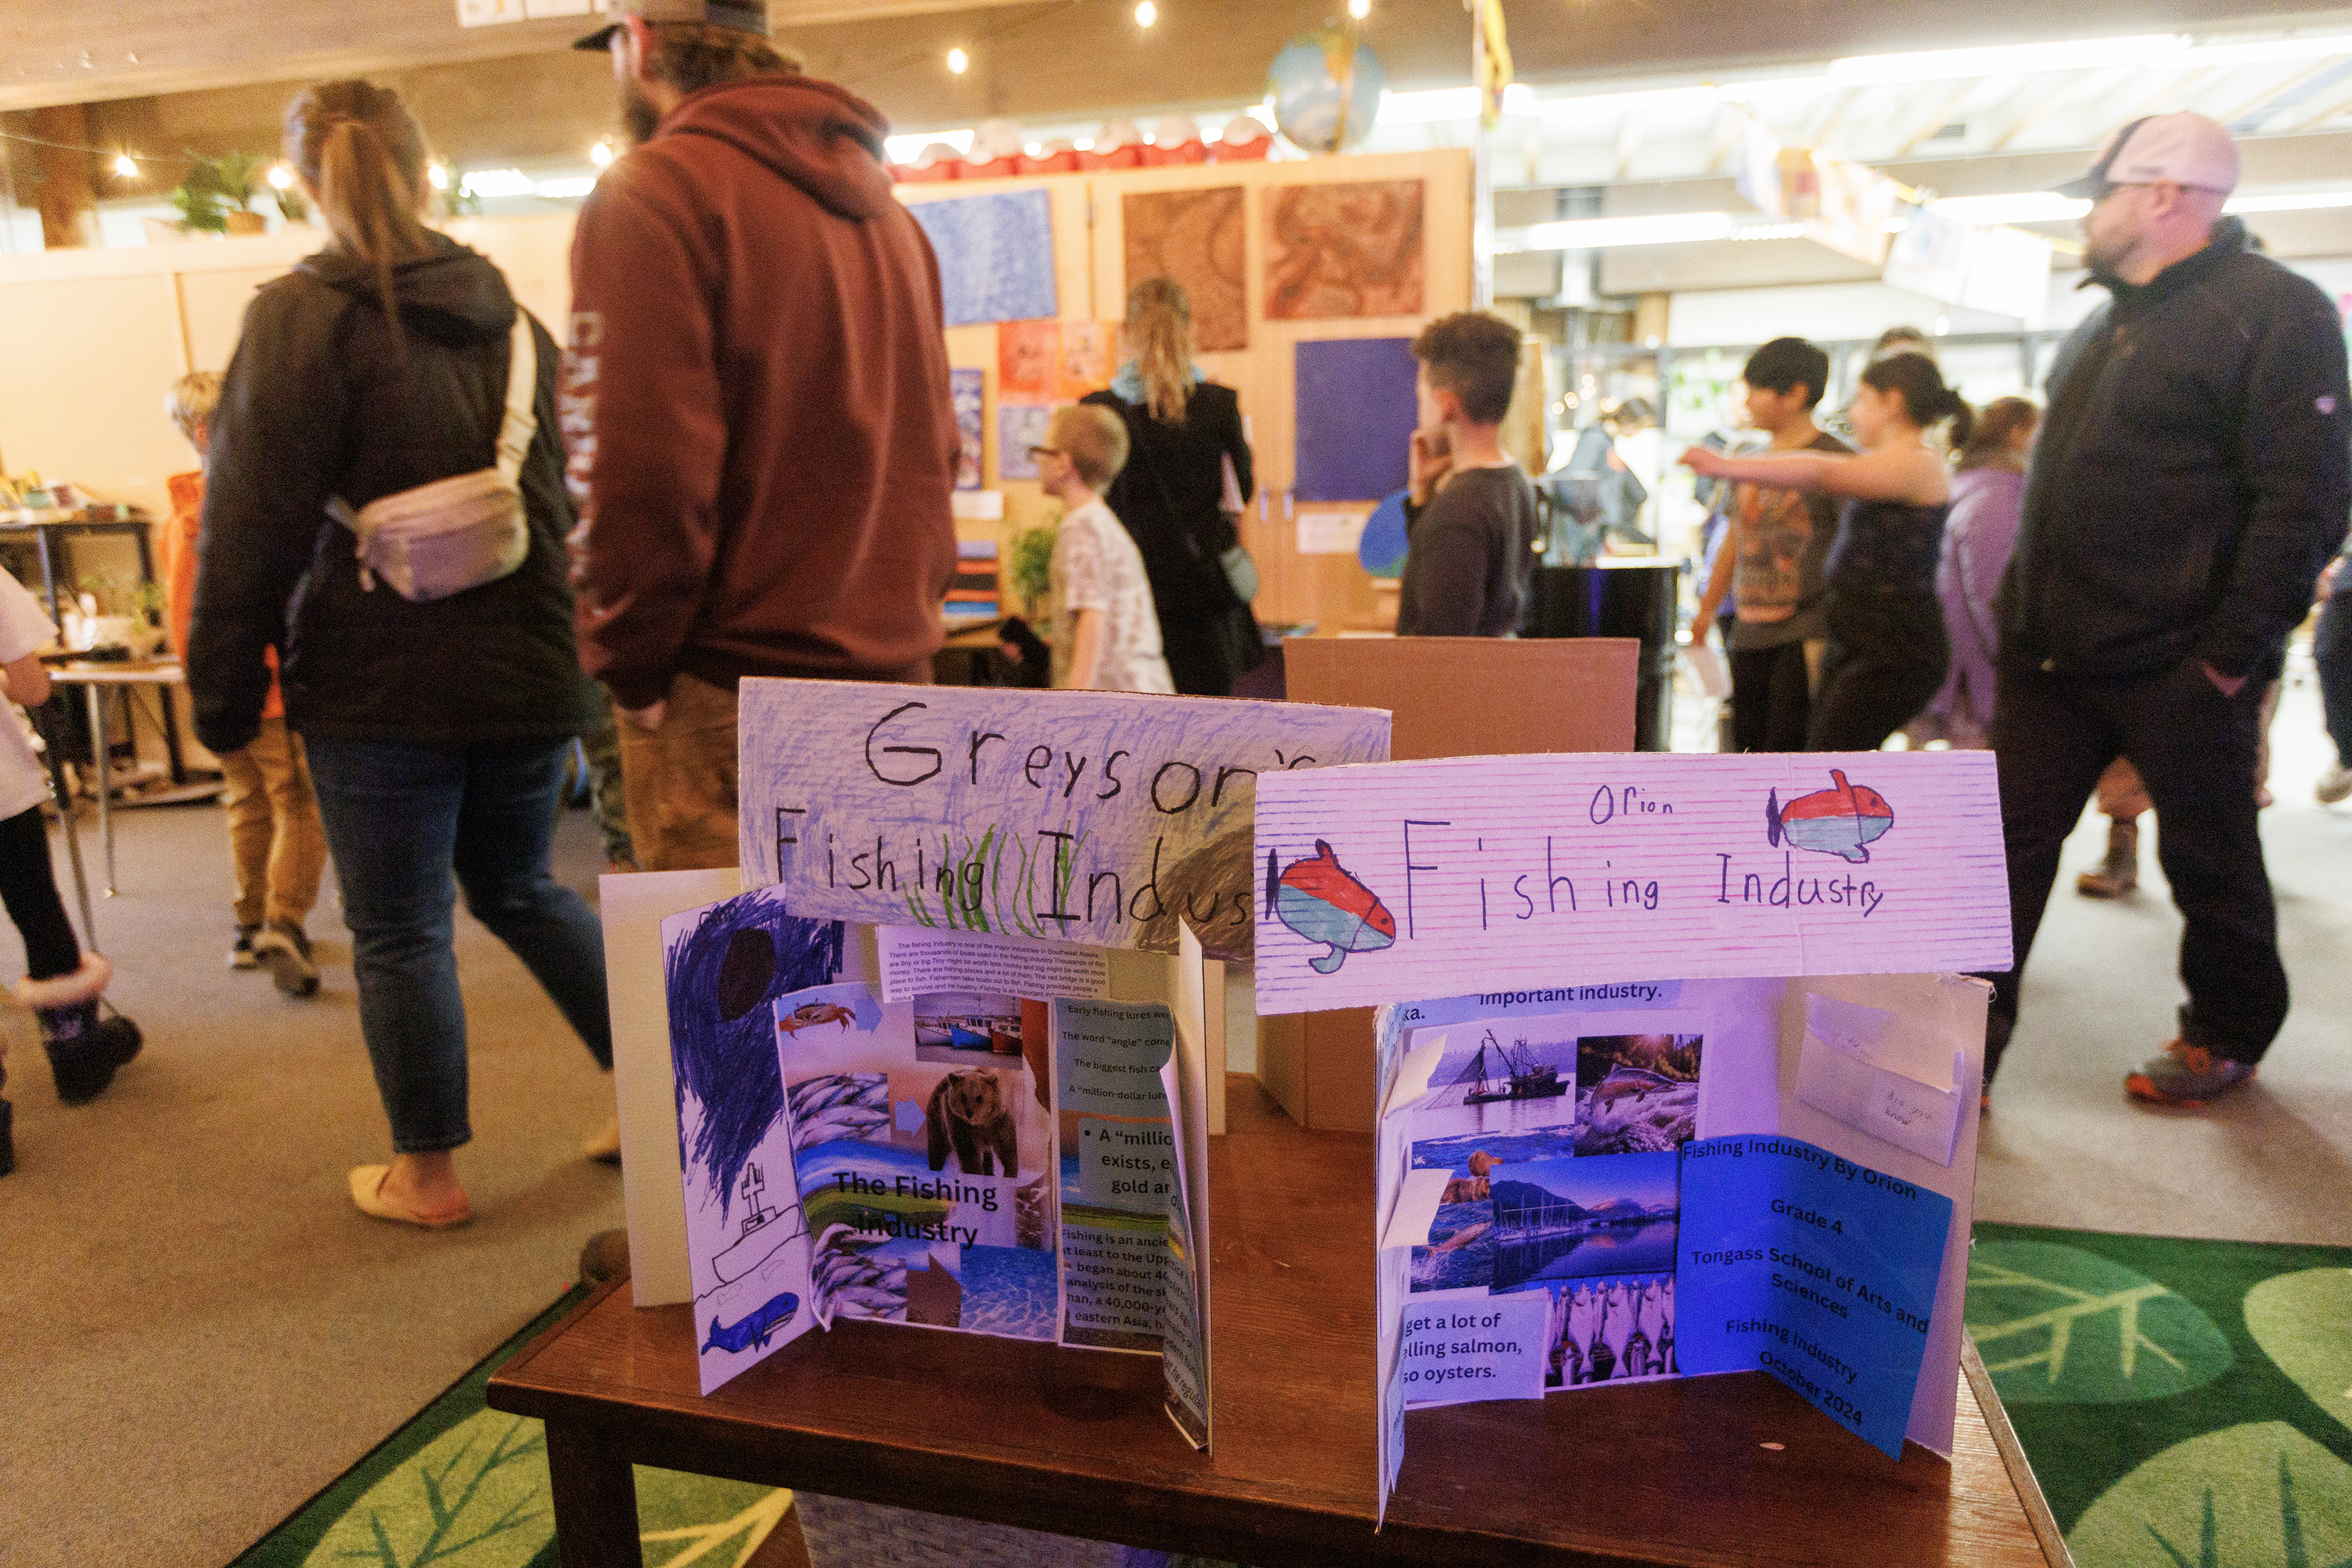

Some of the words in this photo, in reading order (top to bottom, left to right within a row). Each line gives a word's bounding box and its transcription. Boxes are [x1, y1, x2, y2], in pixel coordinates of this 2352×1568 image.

[865, 701, 1316, 814] Greyson'
[1589, 783, 1675, 826] Orion
[775, 805, 985, 911] Fishing
[1037, 829, 1252, 927] Indus
[1403, 818, 1660, 940] Fishing
[1715, 850, 1885, 918] Industry
[1010, 954, 1028, 962] fishing
[980, 984, 1001, 994] Fishing
[1024, 981, 1045, 989] Fishing
[1579, 983, 1662, 1002] industry.
[1068, 1005, 1090, 1016] Early
[1093, 1007, 1124, 1021] fishing
[1126, 1011, 1150, 1019] lures
[1062, 1031, 1079, 1040] The
[1081, 1033, 1104, 1043] word
[1074, 1058, 1090, 1068] The
[1093, 1061, 1126, 1073] biggest
[1129, 1063, 1147, 1074] fish
[1069, 1084, 1076, 1093] A
[1099, 1129, 1110, 1143] A
[1101, 1155, 1156, 1172] exists,
[1683, 1140, 1743, 1160] Fishing
[1748, 1138, 1828, 1170] Industry
[1834, 1157, 1858, 1181] By
[1862, 1167, 1917, 1201] Orion
[832, 1170, 887, 1195] The
[896, 1175, 999, 1212] Fishing
[1111, 1179, 1148, 1195] gold
[1771, 1200, 1827, 1229] Grade
[1831, 1219, 1843, 1235] 4
[1105, 1233, 1115, 1244] is
[1074, 1246, 1104, 1259] least
[1106, 1252, 1120, 1260] to
[1122, 1252, 1143, 1263] the
[1076, 1262, 1113, 1276] began
[1116, 1268, 1152, 1279] about
[1066, 1278, 1115, 1291] analysis
[1118, 1284, 1130, 1292] of
[1133, 1285, 1154, 1296] the
[1691, 1247, 1763, 1266] Tongass
[1768, 1248, 1831, 1284] School
[1836, 1275, 1855, 1293] of
[1857, 1284, 1892, 1316] Arts
[1895, 1306, 1929, 1335] and
[1771, 1273, 1849, 1319] Sciences
[1075, 1311, 1120, 1325] eastern
[1123, 1315, 1152, 1331] Asia,
[1436, 1319, 1446, 1329] a
[1452, 1314, 1476, 1329] lot
[1481, 1313, 1502, 1328] of
[1450, 1339, 1522, 1356] salmon,
[1726, 1318, 1789, 1346] Fishing
[1793, 1331, 1857, 1385] Industry
[1425, 1365, 1497, 1384] oysters.
[1759, 1351, 1821, 1398] October
[1823, 1389, 1864, 1426] 2024
